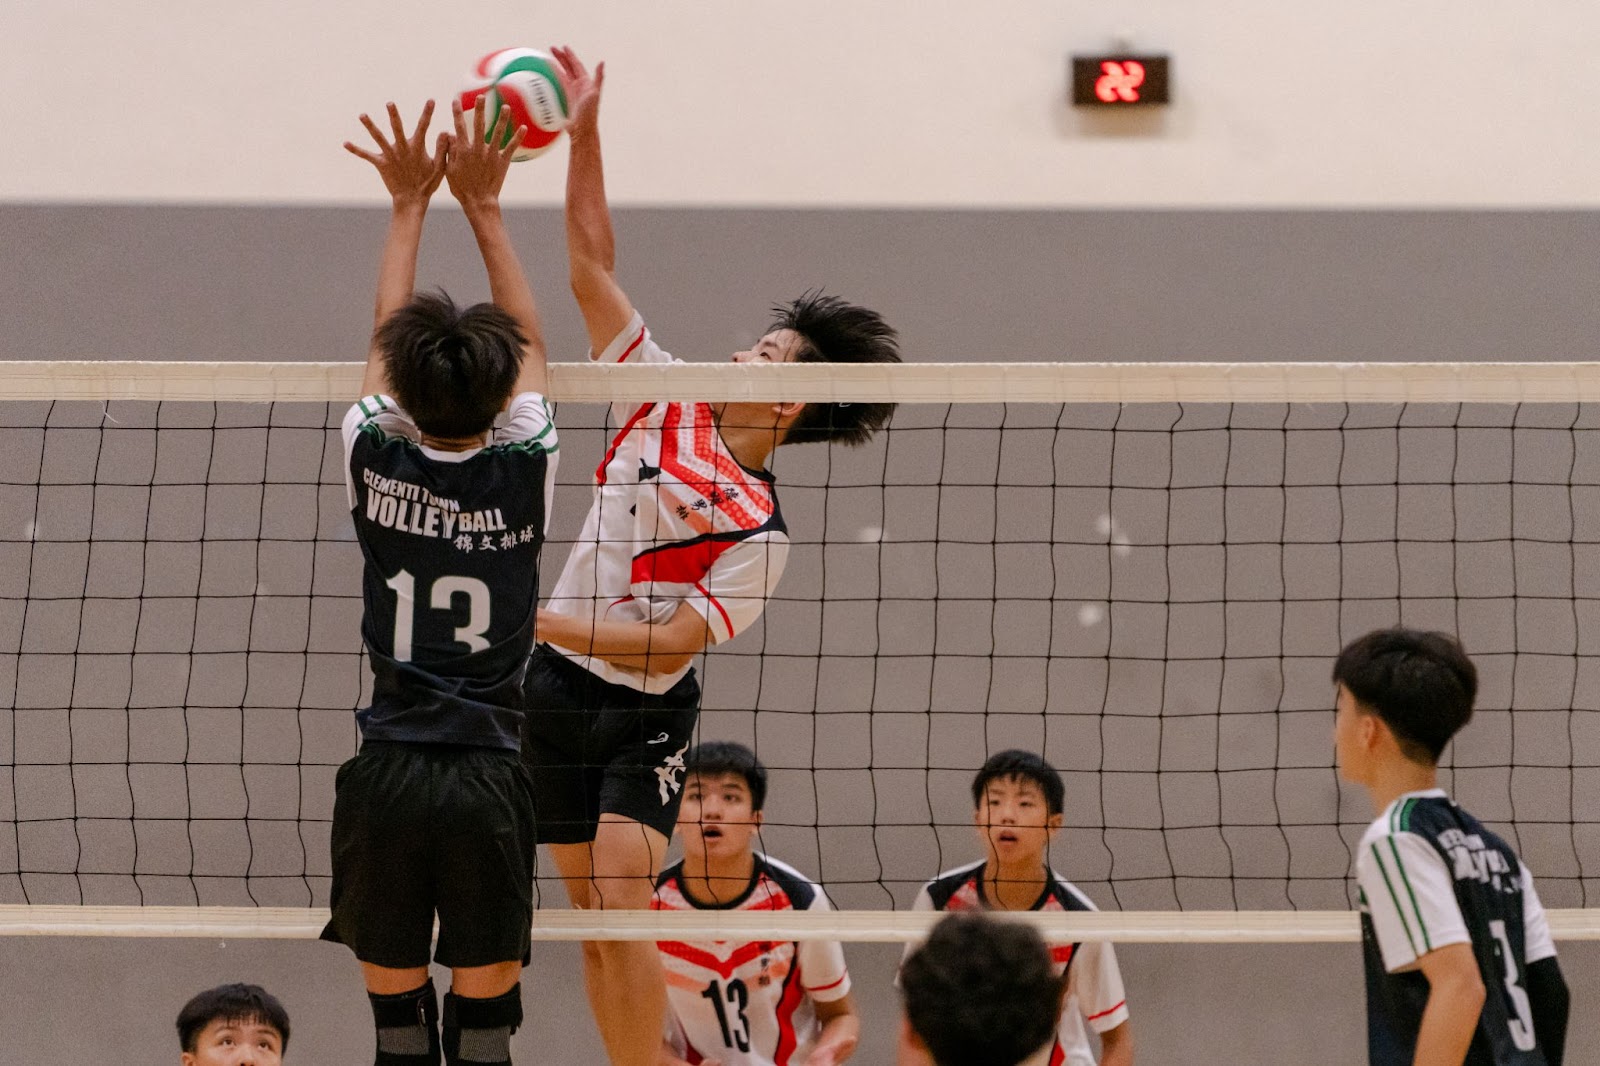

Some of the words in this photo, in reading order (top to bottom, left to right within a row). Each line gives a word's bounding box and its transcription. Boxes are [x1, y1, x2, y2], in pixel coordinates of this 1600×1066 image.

[363, 467, 420, 501] CLEMENTI
[366, 487, 507, 539] VOLLEYBALL
[385, 568, 491, 662] 13
[701, 978, 750, 1053] 13
